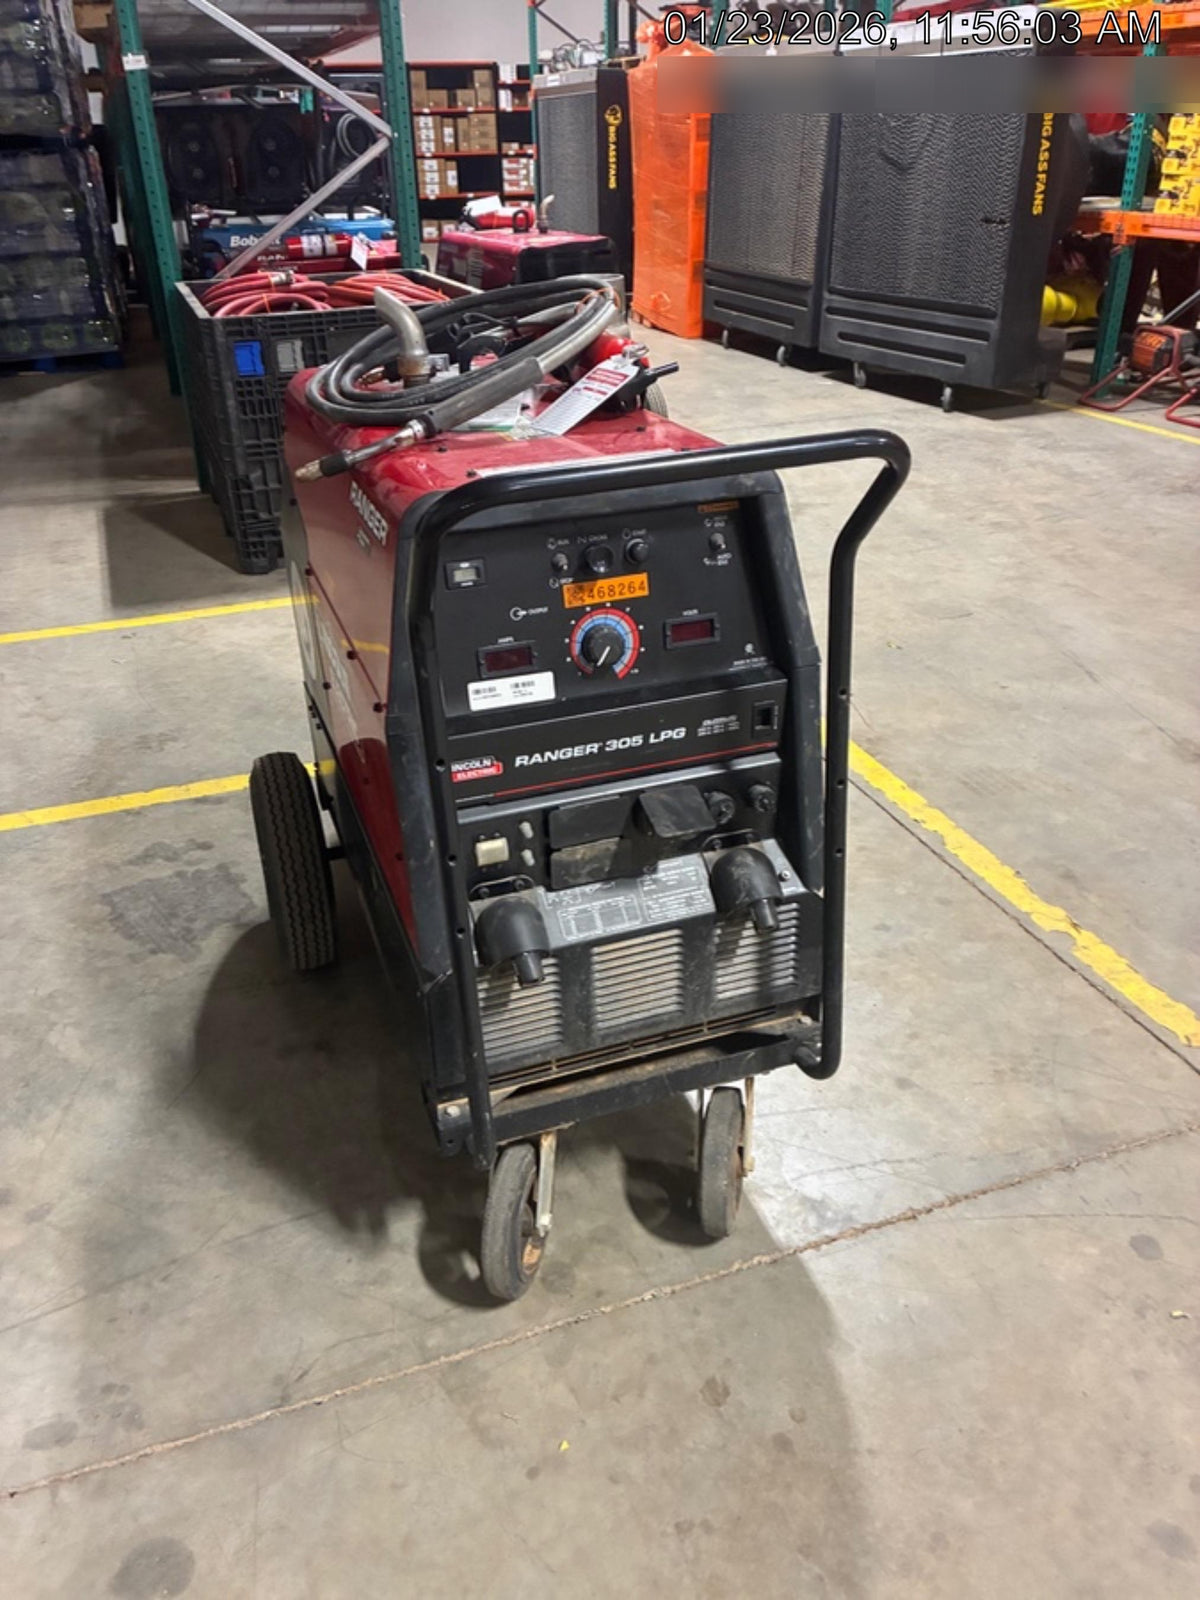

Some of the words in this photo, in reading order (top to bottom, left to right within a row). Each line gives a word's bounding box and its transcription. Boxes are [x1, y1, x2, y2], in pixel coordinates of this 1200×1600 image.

[1037, 138, 1052, 172] ASS
[1031, 173, 1048, 216] FANS
[349, 480, 389, 547] RANGER
[586, 579, 646, 600] 468264
[514, 742, 600, 768] RANGER
[604, 734, 645, 752] 305
[648, 726, 688, 745] LPG
